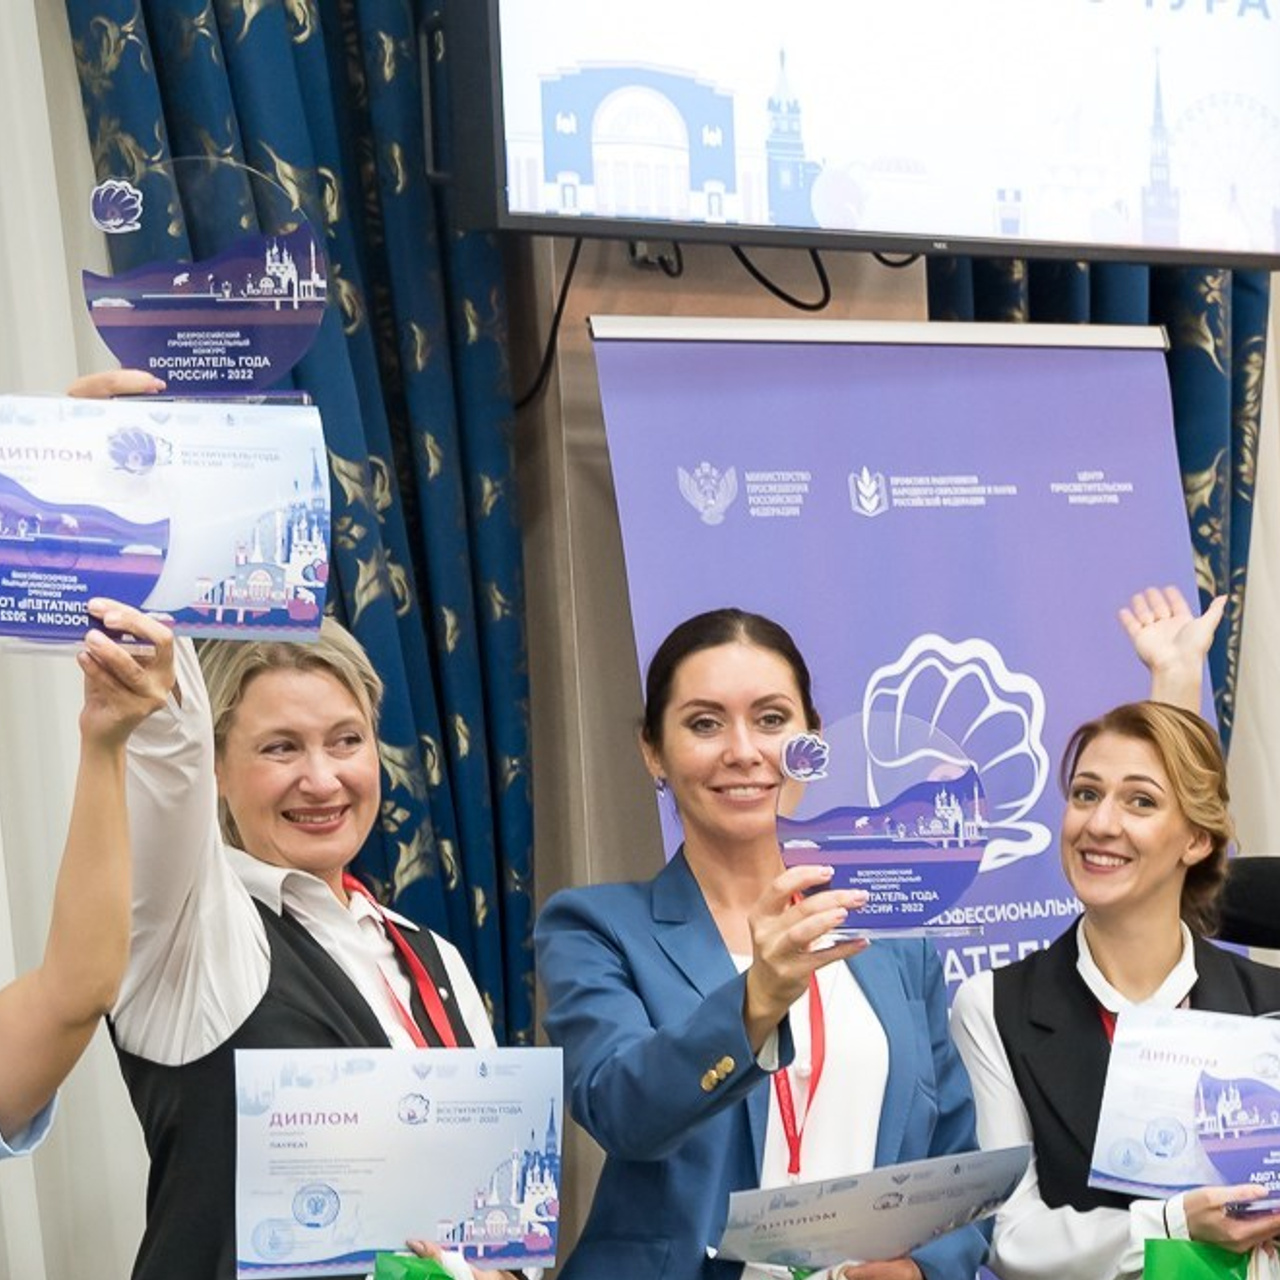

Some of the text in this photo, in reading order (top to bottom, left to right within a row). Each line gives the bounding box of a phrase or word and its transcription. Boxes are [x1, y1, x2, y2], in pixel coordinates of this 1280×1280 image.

[149, 356, 271, 368] ВОСПИТАТЕЛЬ ГОДА
[168, 370, 218, 380] РОССИИ
[227, 369, 253, 380] 2022
[868, 890, 940, 902] ТАТЕЛЬ ГОДА
[923, 897, 1086, 926] ОФЕССИОНАЛЬН
[269, 1112, 359, 1128] ДИПЛОМ
